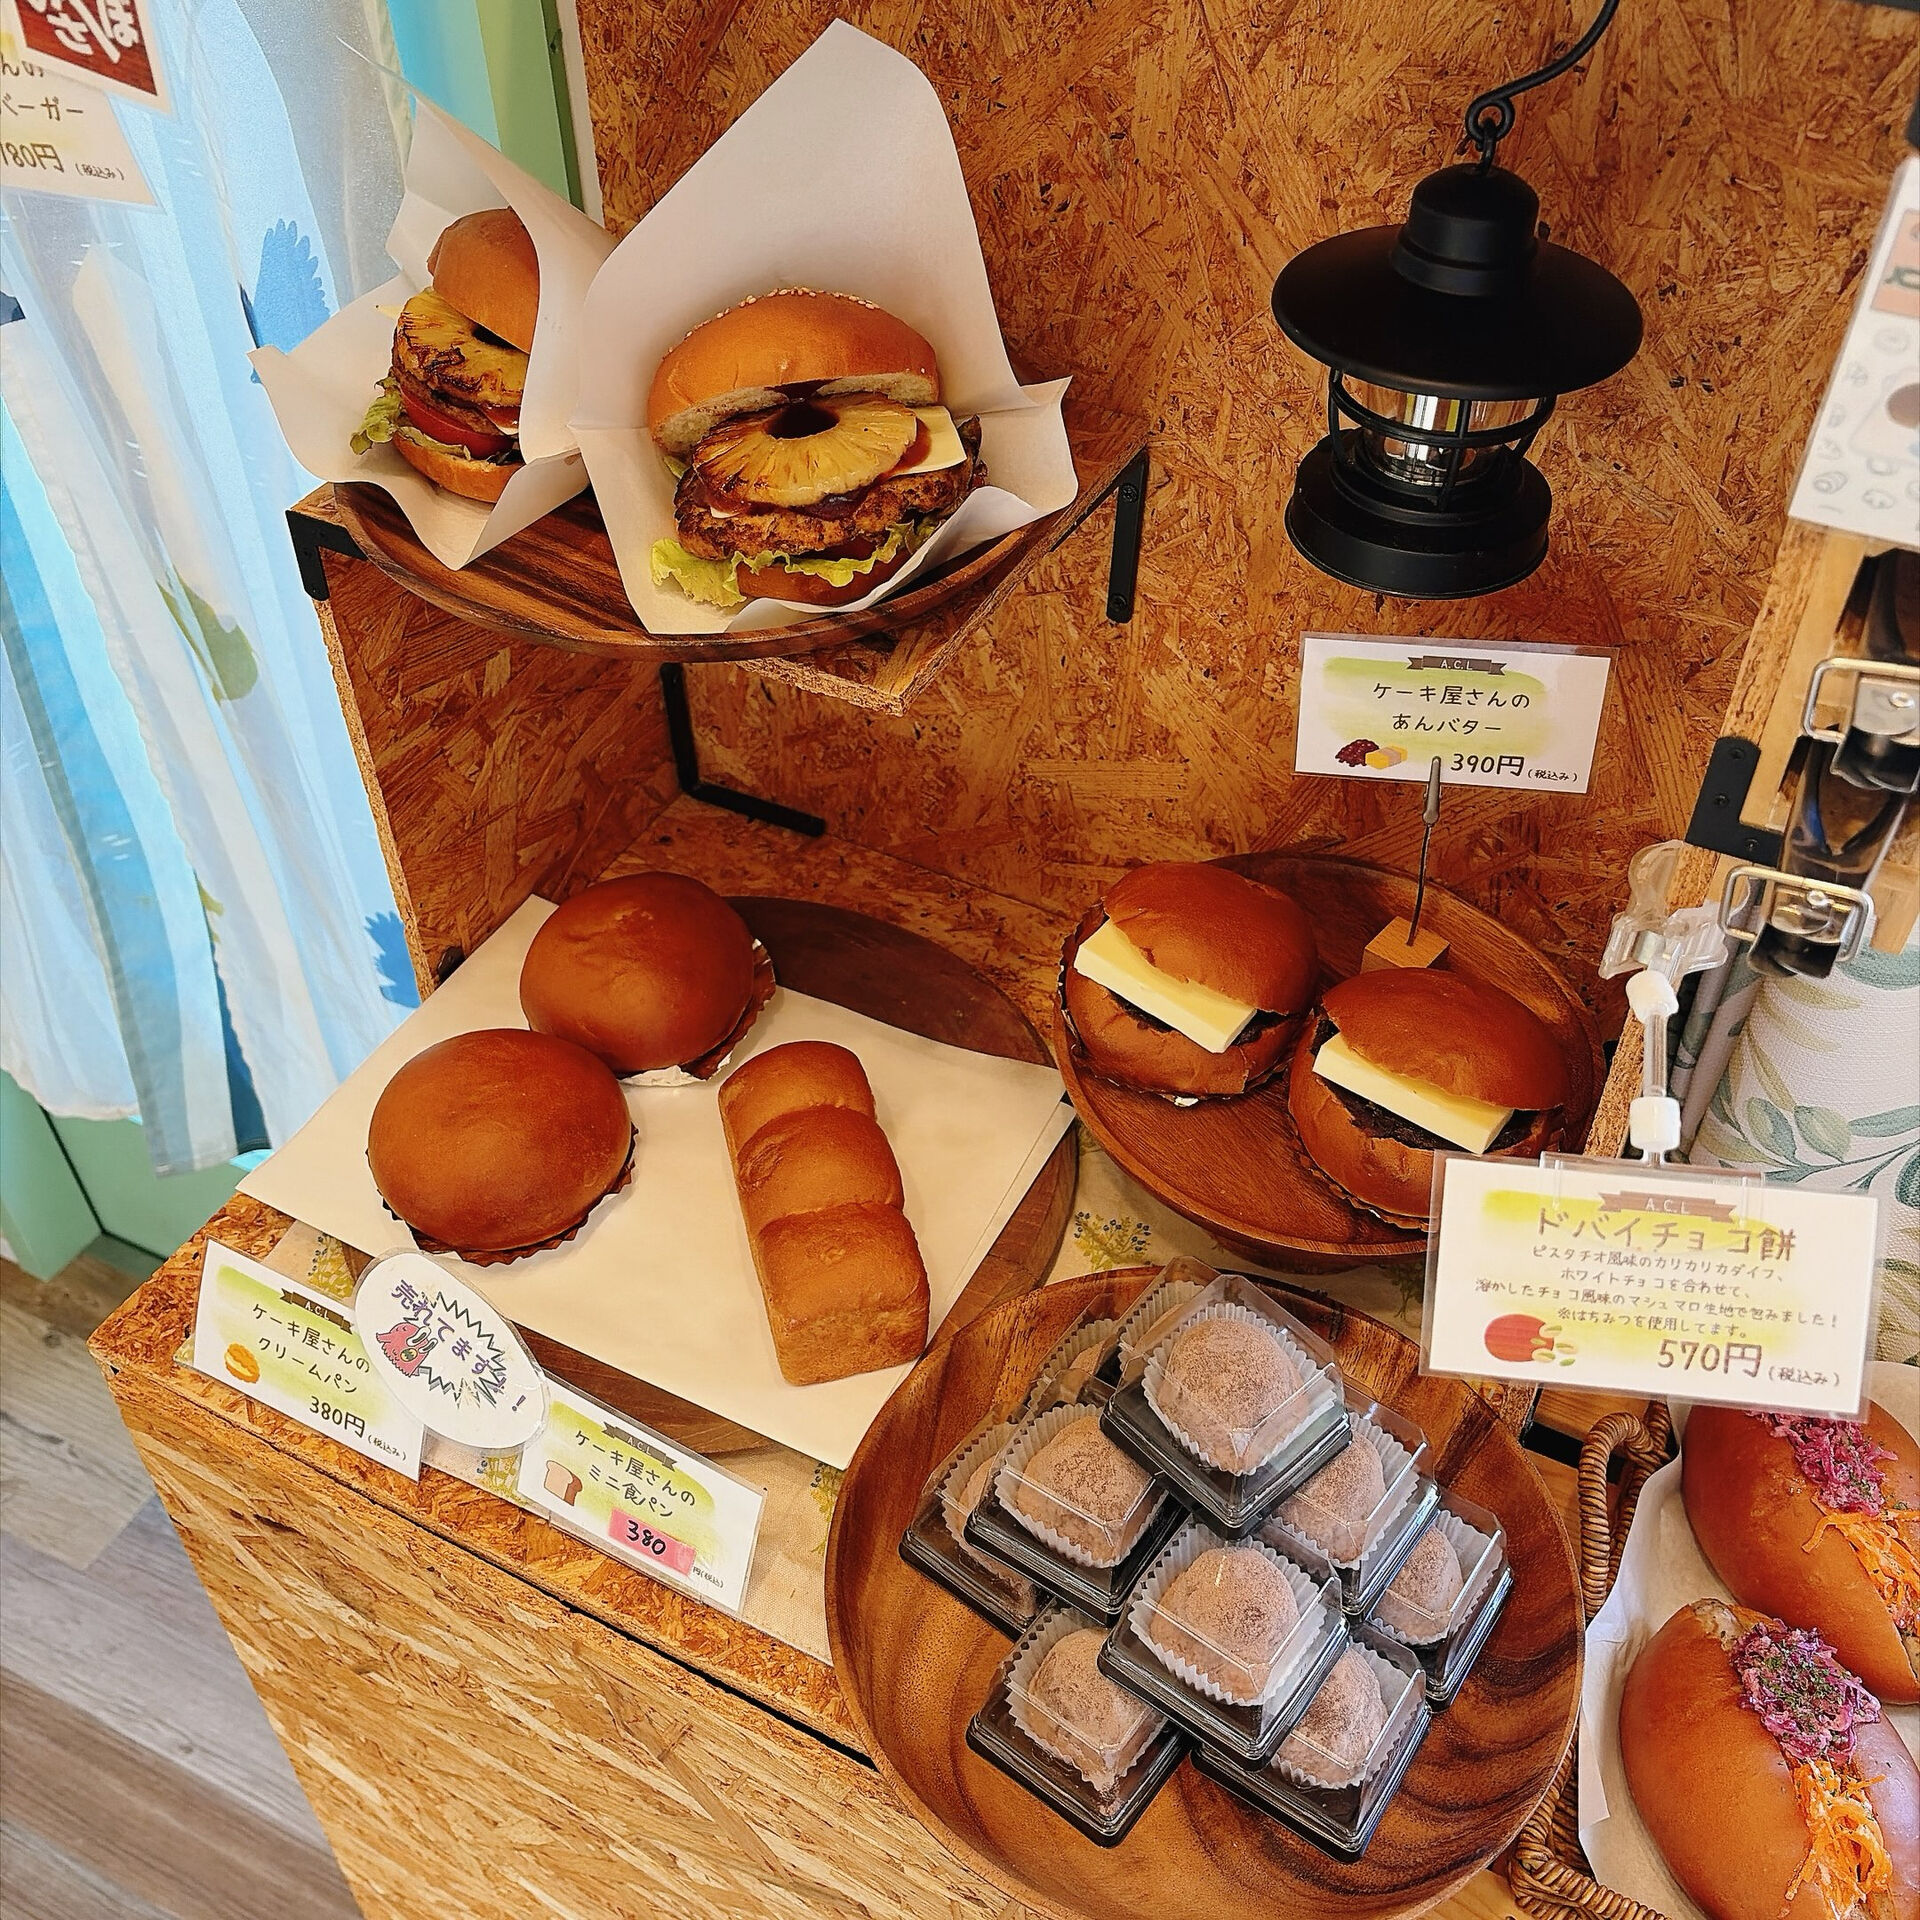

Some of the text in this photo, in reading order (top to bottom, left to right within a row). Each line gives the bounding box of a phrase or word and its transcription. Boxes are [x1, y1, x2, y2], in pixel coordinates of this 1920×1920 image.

[1440, 659, 1473, 671] A.C.L
[1372, 682, 1531, 709] ケーキ屋さんの
[1391, 713, 1502, 736] あんバター
[1449, 753, 1578, 783] 390円 (税込み)
[1645, 1198, 1690, 1215] A.C.L
[1538, 1207, 1797, 1262] ドバイチョコ餅
[1560, 1267, 1750, 1299] ホワイトチョコを合わせて、
[252, 1303, 371, 1374] ケーキ屋さんの
[257, 1337, 359, 1395] クリームパン
[1657, 1339, 1841, 1387] 570円 (税込み)
[308, 1395, 366, 1440] 380円
[574, 1429, 697, 1507] ケーキ屋さんの
[588, 1464, 674, 1519] ミニ食パン
[625, 1519, 668, 1556] 380
